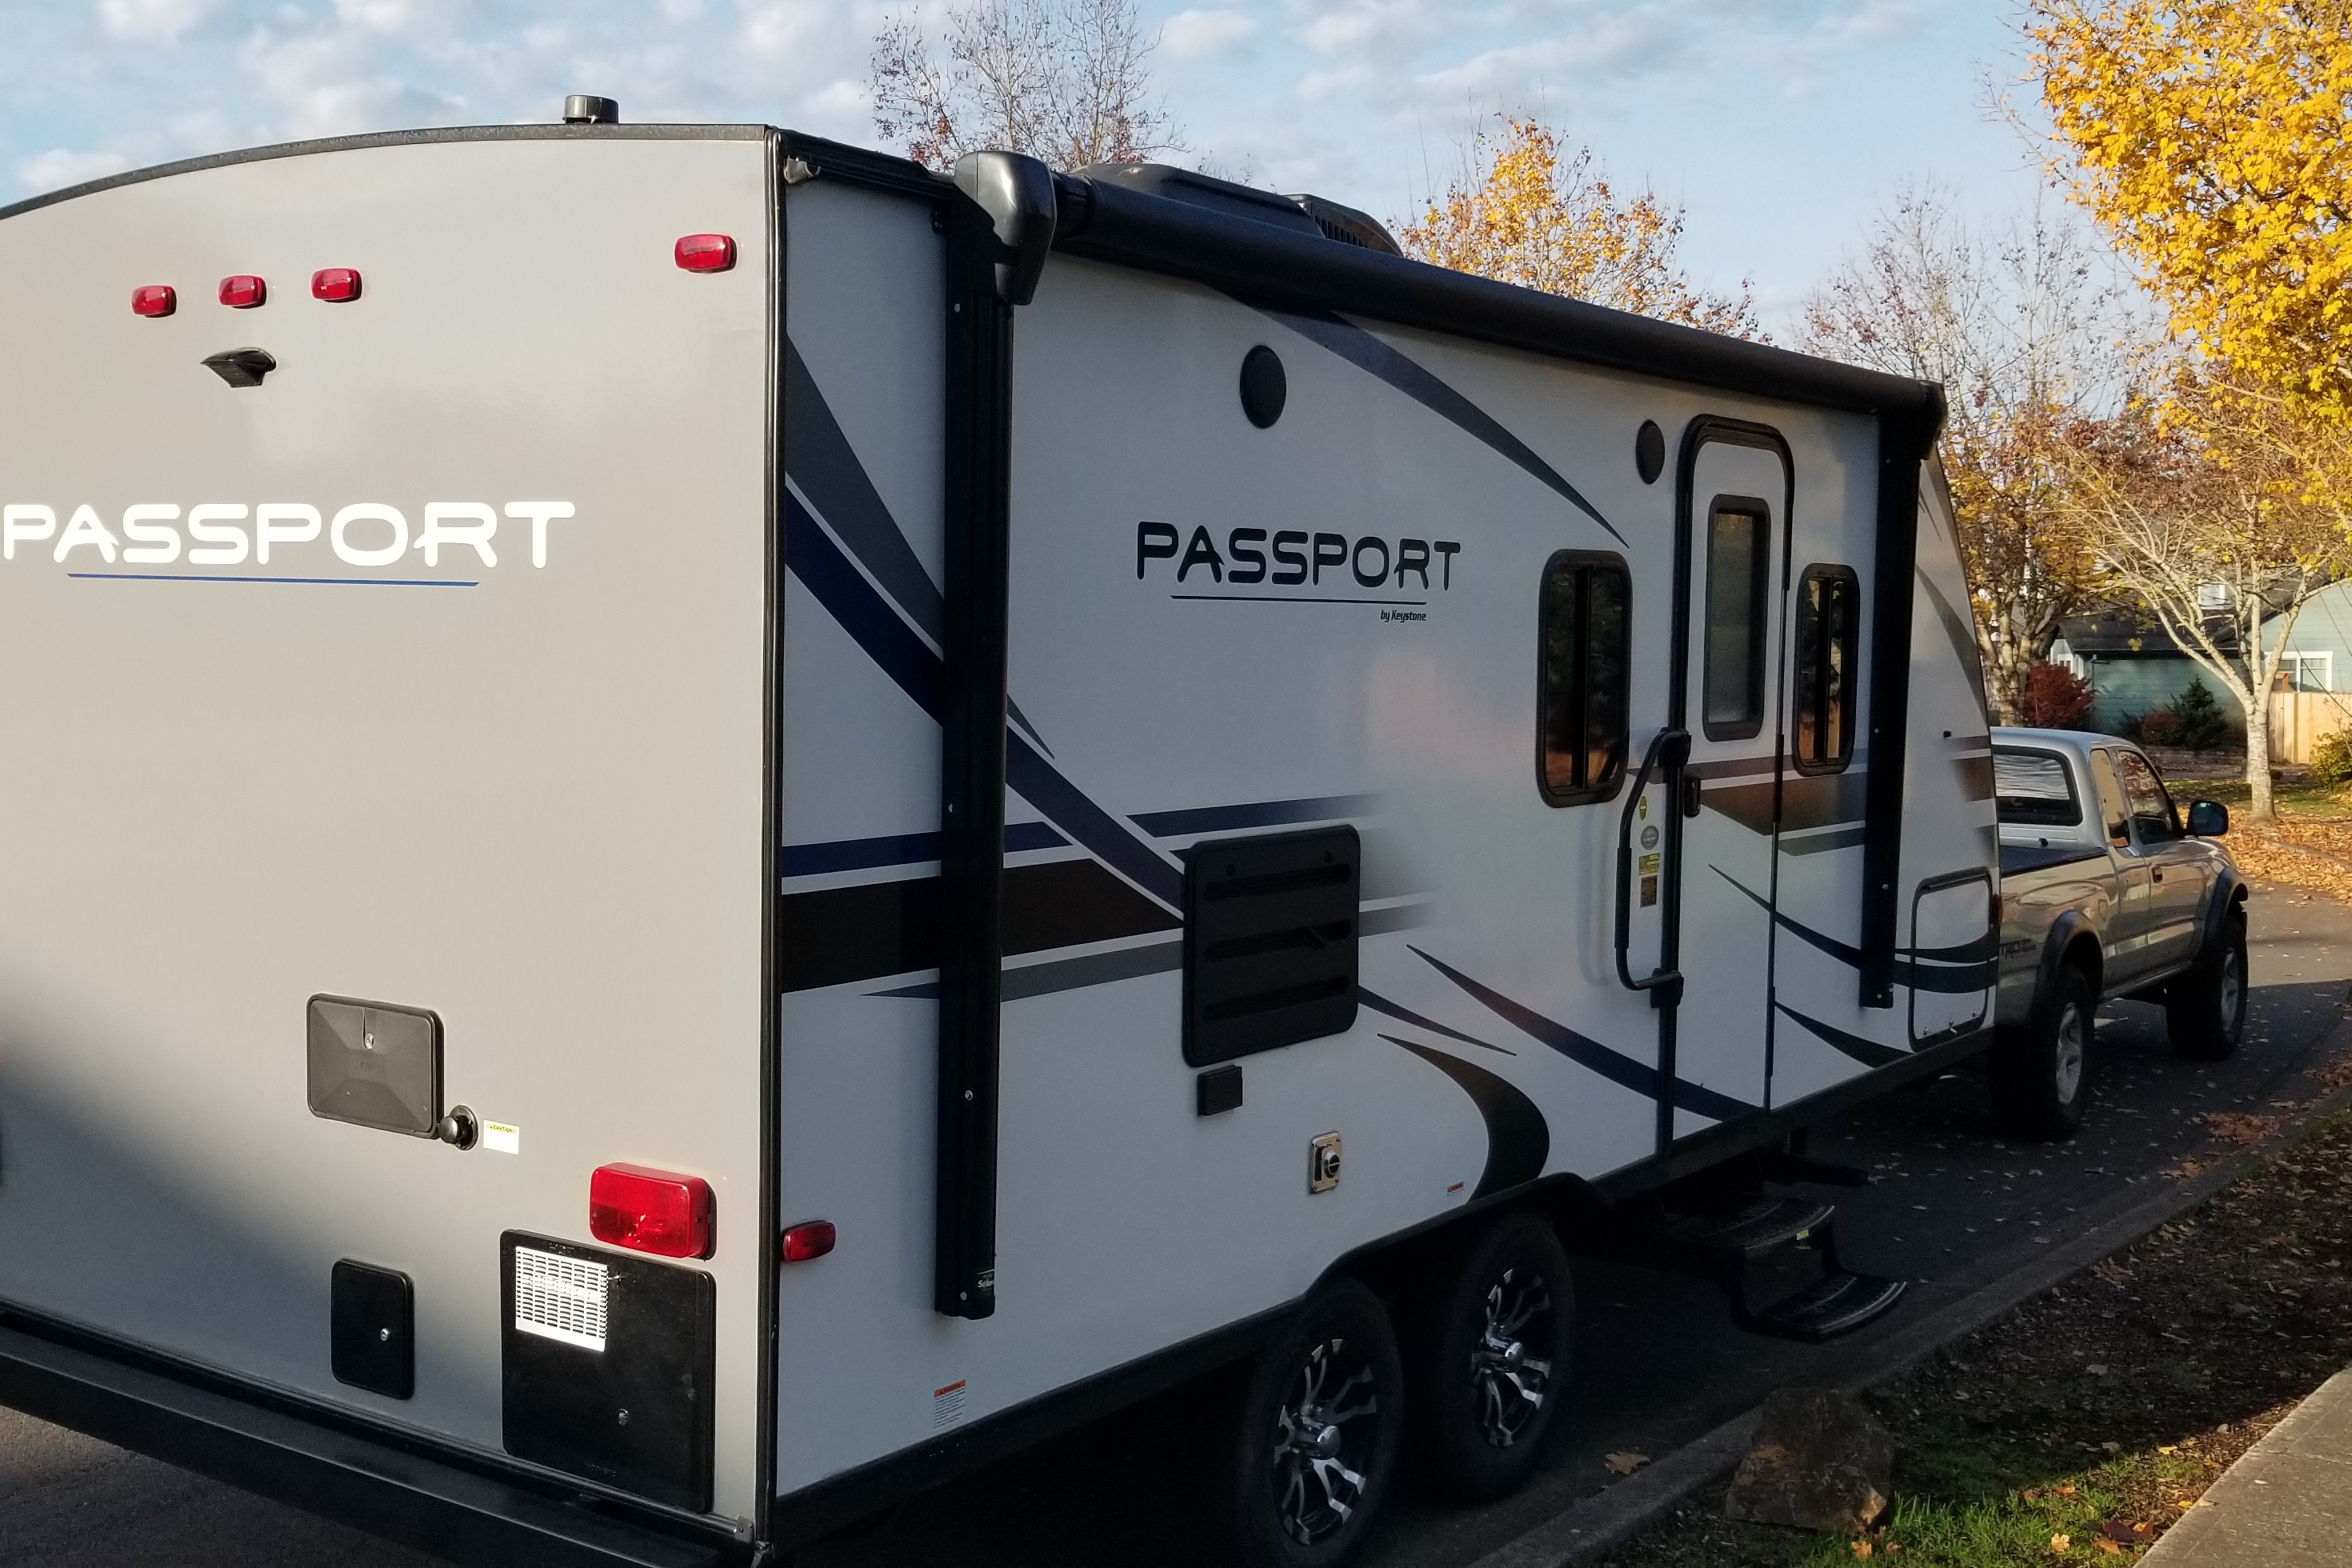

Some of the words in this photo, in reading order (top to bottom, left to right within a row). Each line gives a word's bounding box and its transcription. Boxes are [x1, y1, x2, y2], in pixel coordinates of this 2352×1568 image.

[3, 501, 576, 569] PASSPORT
[1137, 521, 1461, 591] PASSPORT
[1380, 609, 1390, 622] by
[1391, 609, 1426, 623] Keystone
